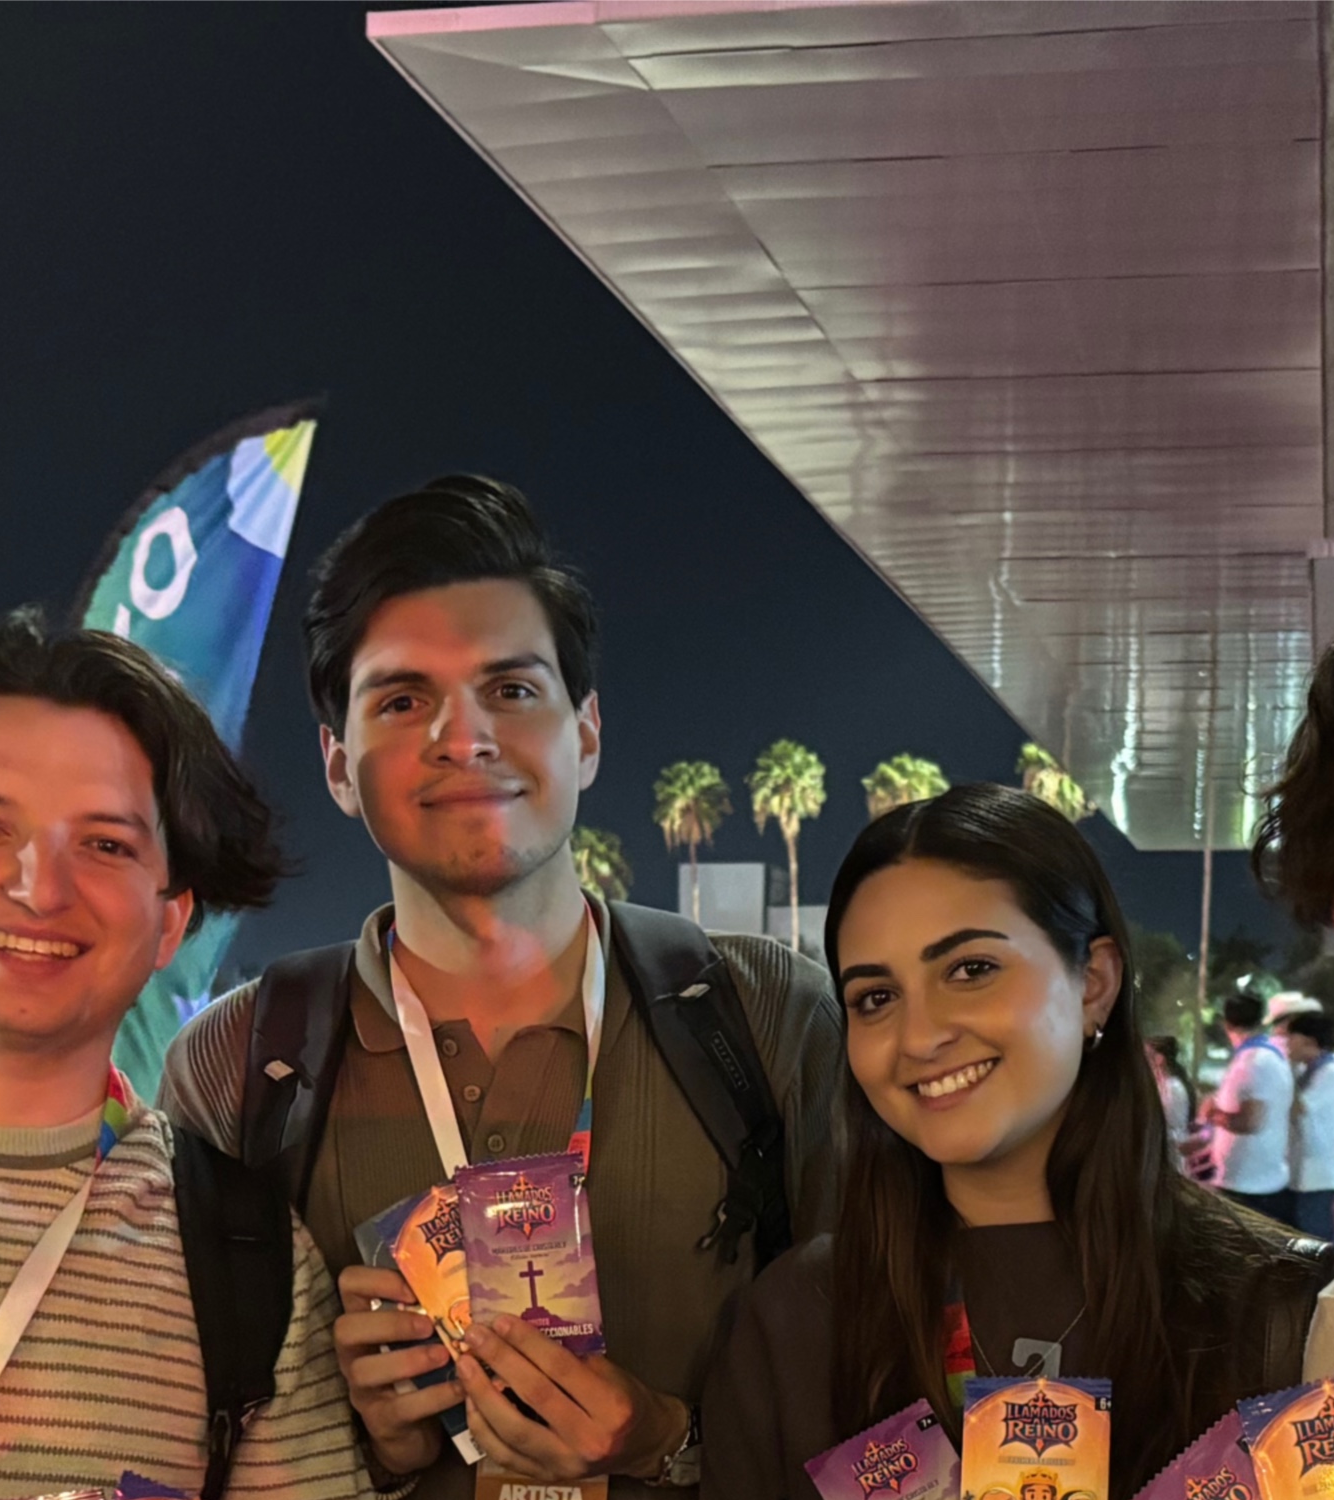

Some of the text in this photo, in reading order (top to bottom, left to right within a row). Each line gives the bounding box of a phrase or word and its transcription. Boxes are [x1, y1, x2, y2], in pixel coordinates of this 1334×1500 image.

[496, 1187, 552, 1204] LLAMADOS
[497, 1203, 556, 1228] REINO
[540, 1323, 594, 1337] CCIONABLES
[1006, 1404, 1077, 1421] LLAMADOS
[1004, 1420, 1078, 1441] REINO
[852, 1439, 909, 1473] LLAMADOS
[859, 1452, 918, 1492] REINO
